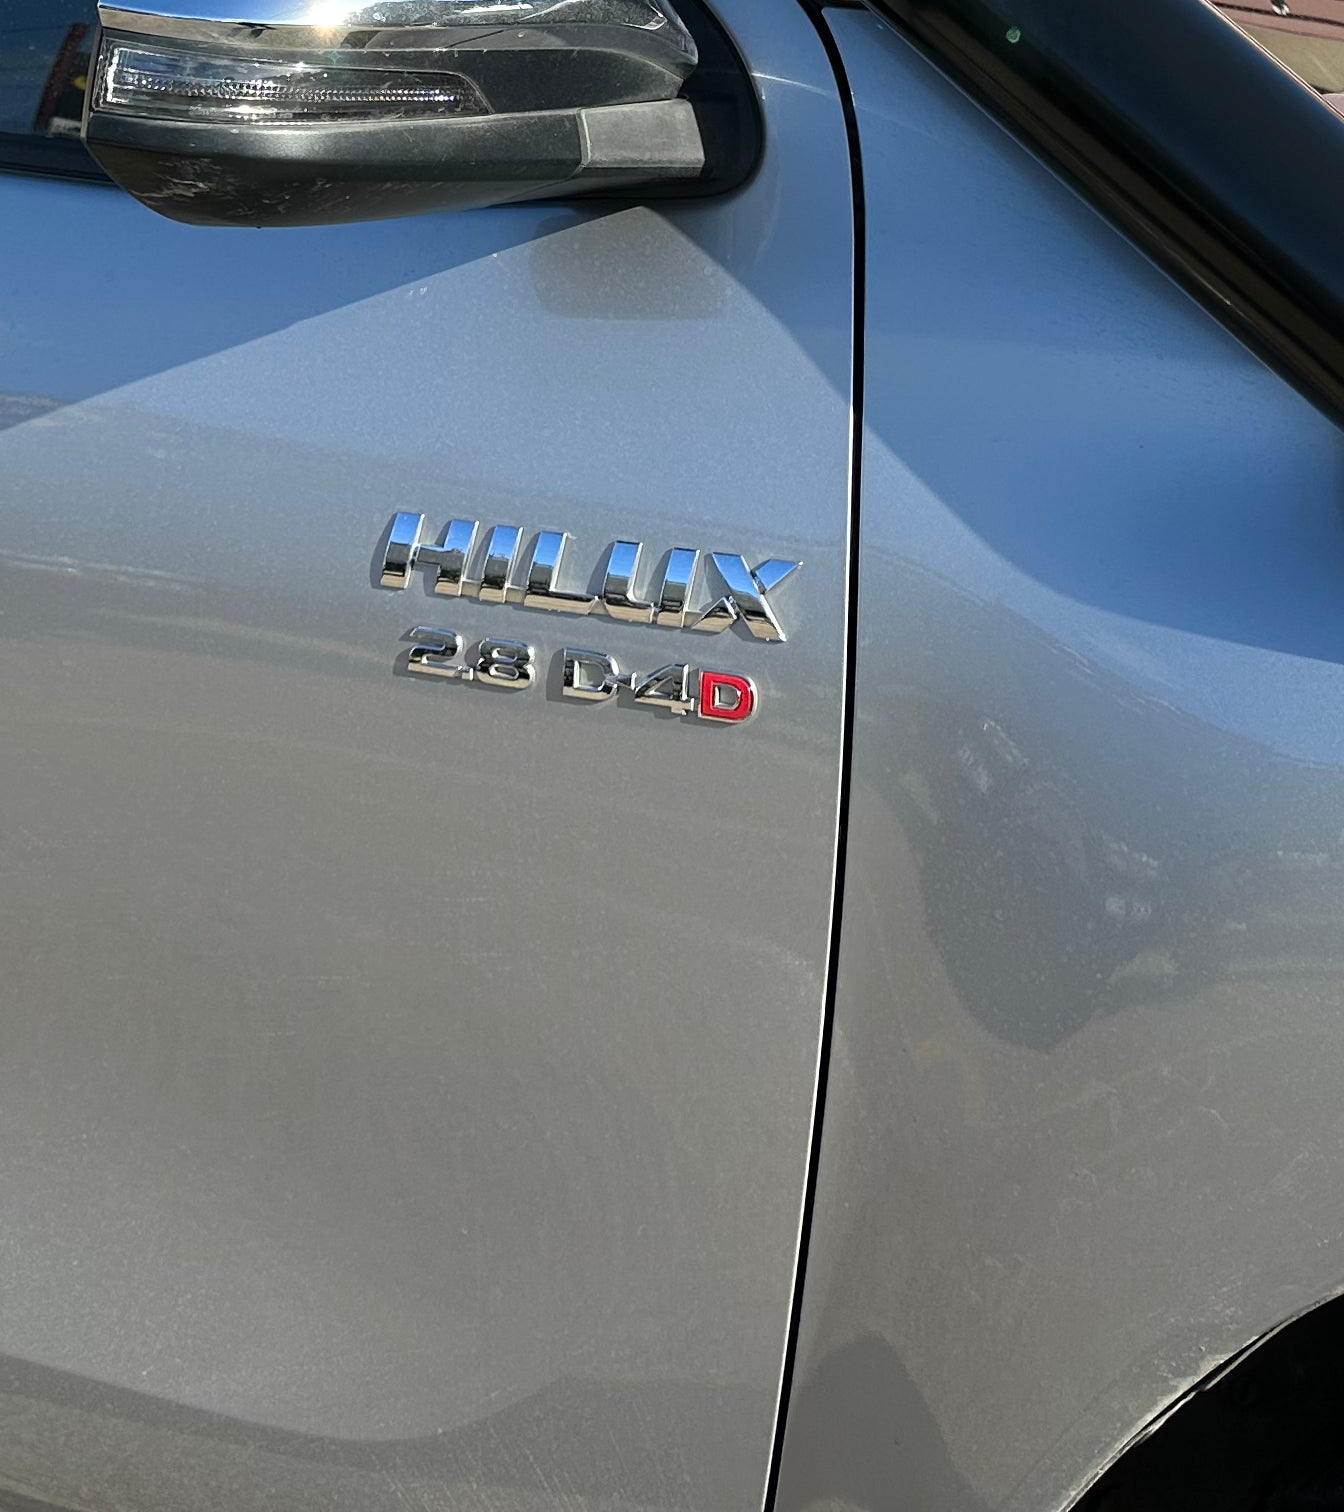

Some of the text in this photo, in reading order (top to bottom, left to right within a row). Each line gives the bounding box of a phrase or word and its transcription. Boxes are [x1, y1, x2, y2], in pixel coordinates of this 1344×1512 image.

[380, 512, 803, 642] HILUX
[408, 625, 758, 723] 2.8 D-4D
